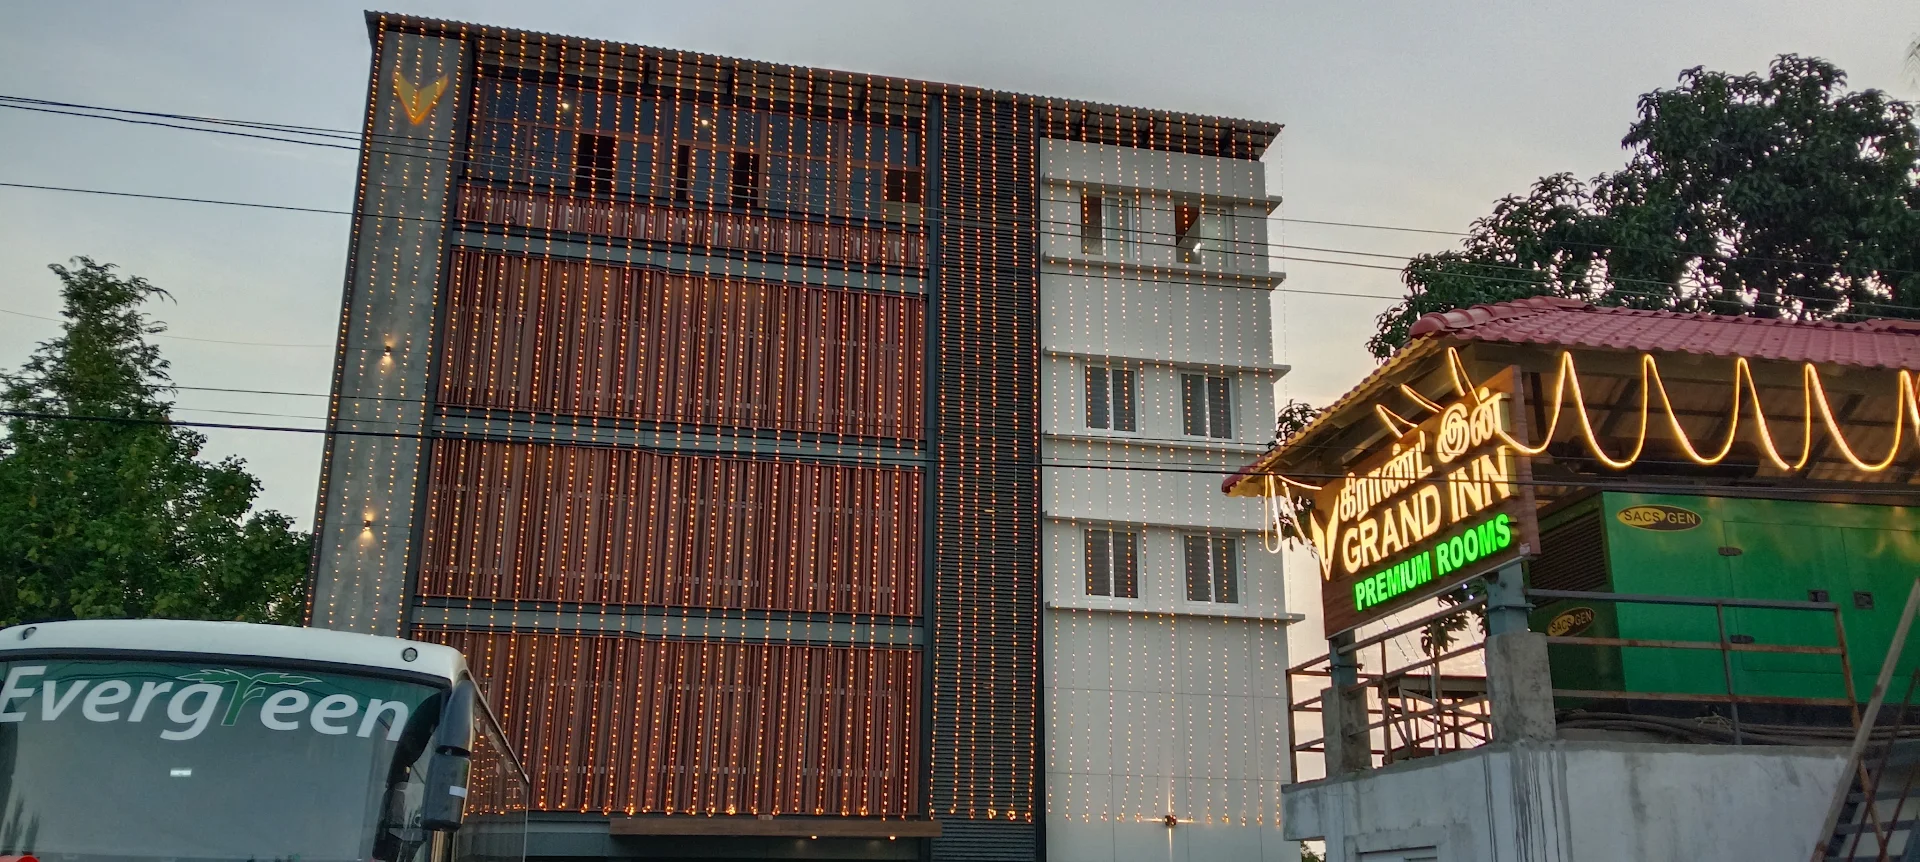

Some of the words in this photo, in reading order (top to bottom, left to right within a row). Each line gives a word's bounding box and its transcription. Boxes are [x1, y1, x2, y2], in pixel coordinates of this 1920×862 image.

[1436, 387, 1504, 464] இன்
[1342, 484, 1442, 574] GRAND
[1448, 445, 1511, 523] INN
[1624, 510, 1661, 523] SACS
[1666, 512, 1697, 525] GEN
[1354, 550, 1432, 611] PREMIUM
[1435, 513, 1512, 577] ROOMS
[1551, 617, 1573, 633] SACS
[1574, 610, 1592, 626] GEN
[0, 665, 410, 742] Evergreen
